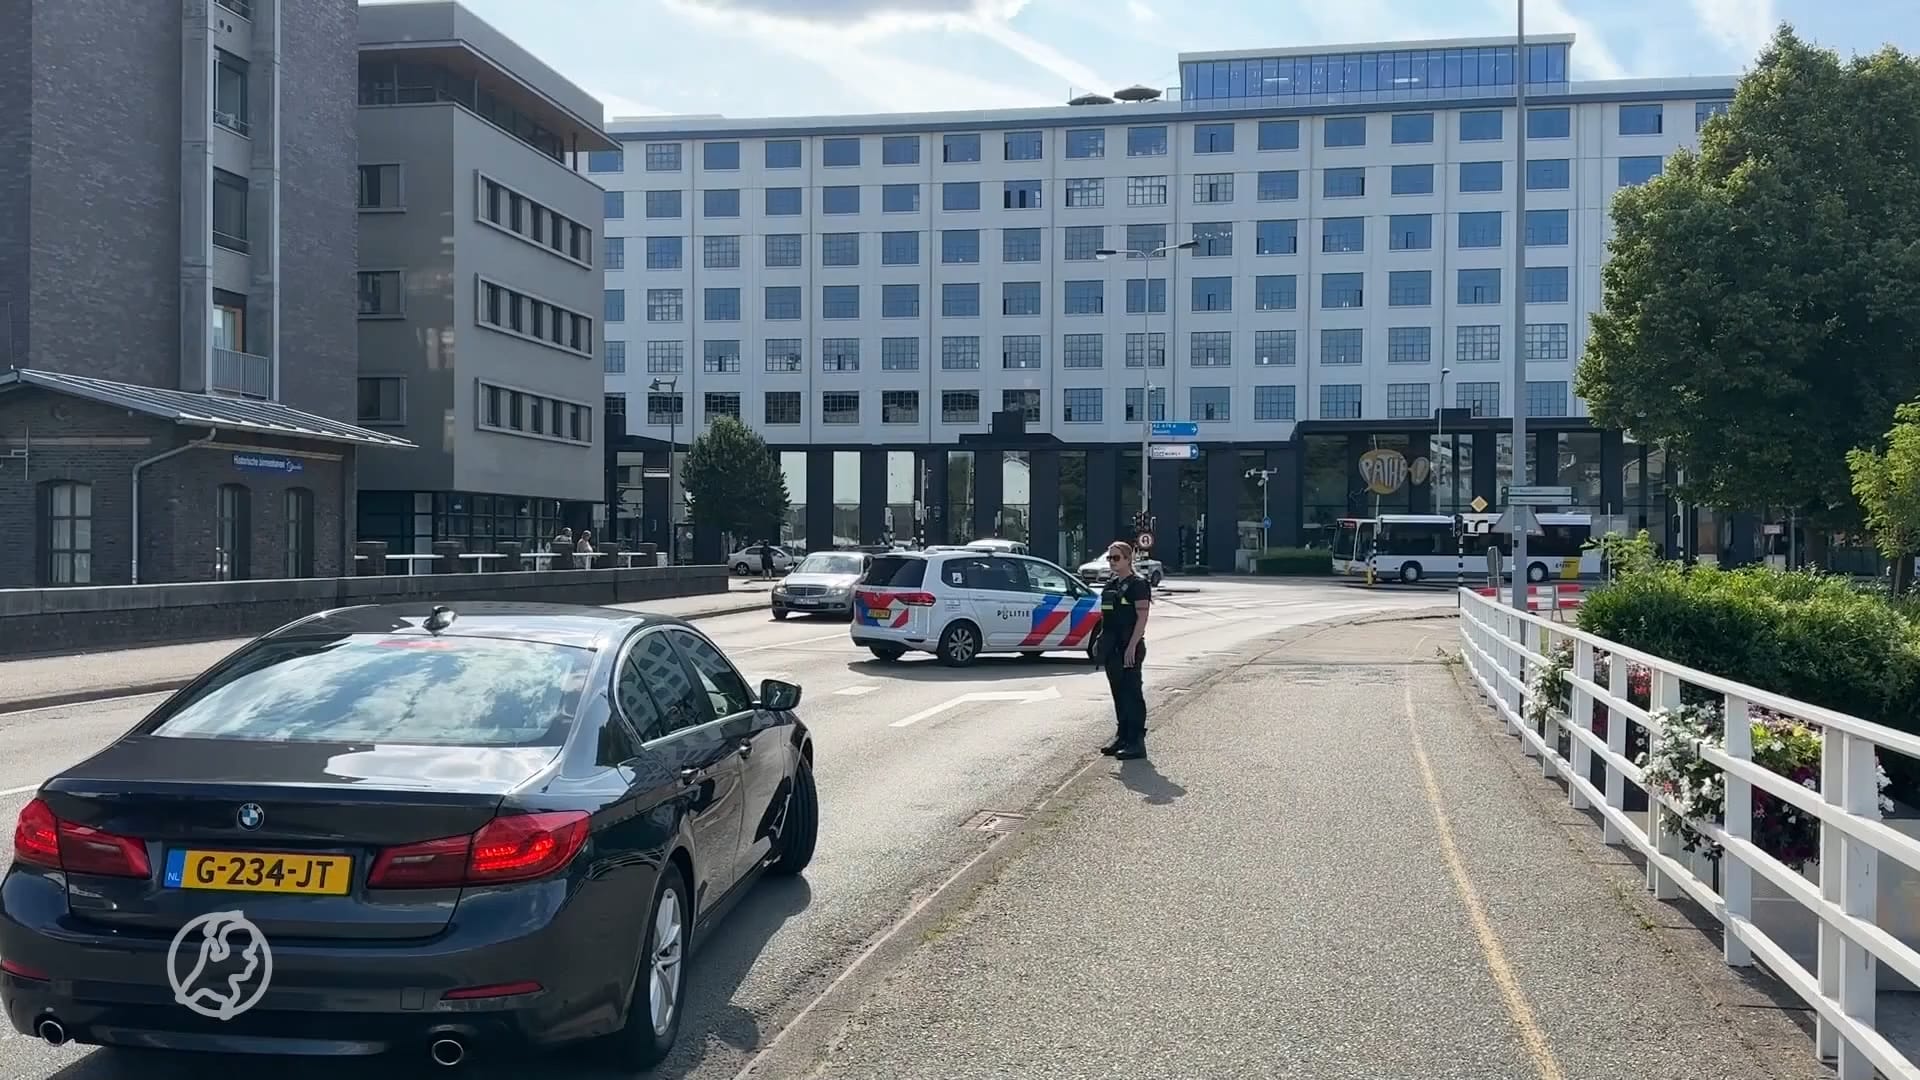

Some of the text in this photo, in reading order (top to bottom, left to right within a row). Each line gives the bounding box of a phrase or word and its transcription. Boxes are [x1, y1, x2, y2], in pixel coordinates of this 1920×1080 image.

[997, 608, 1030, 620] POLITIE
[168, 855, 334, 889] NL G-234-JT
